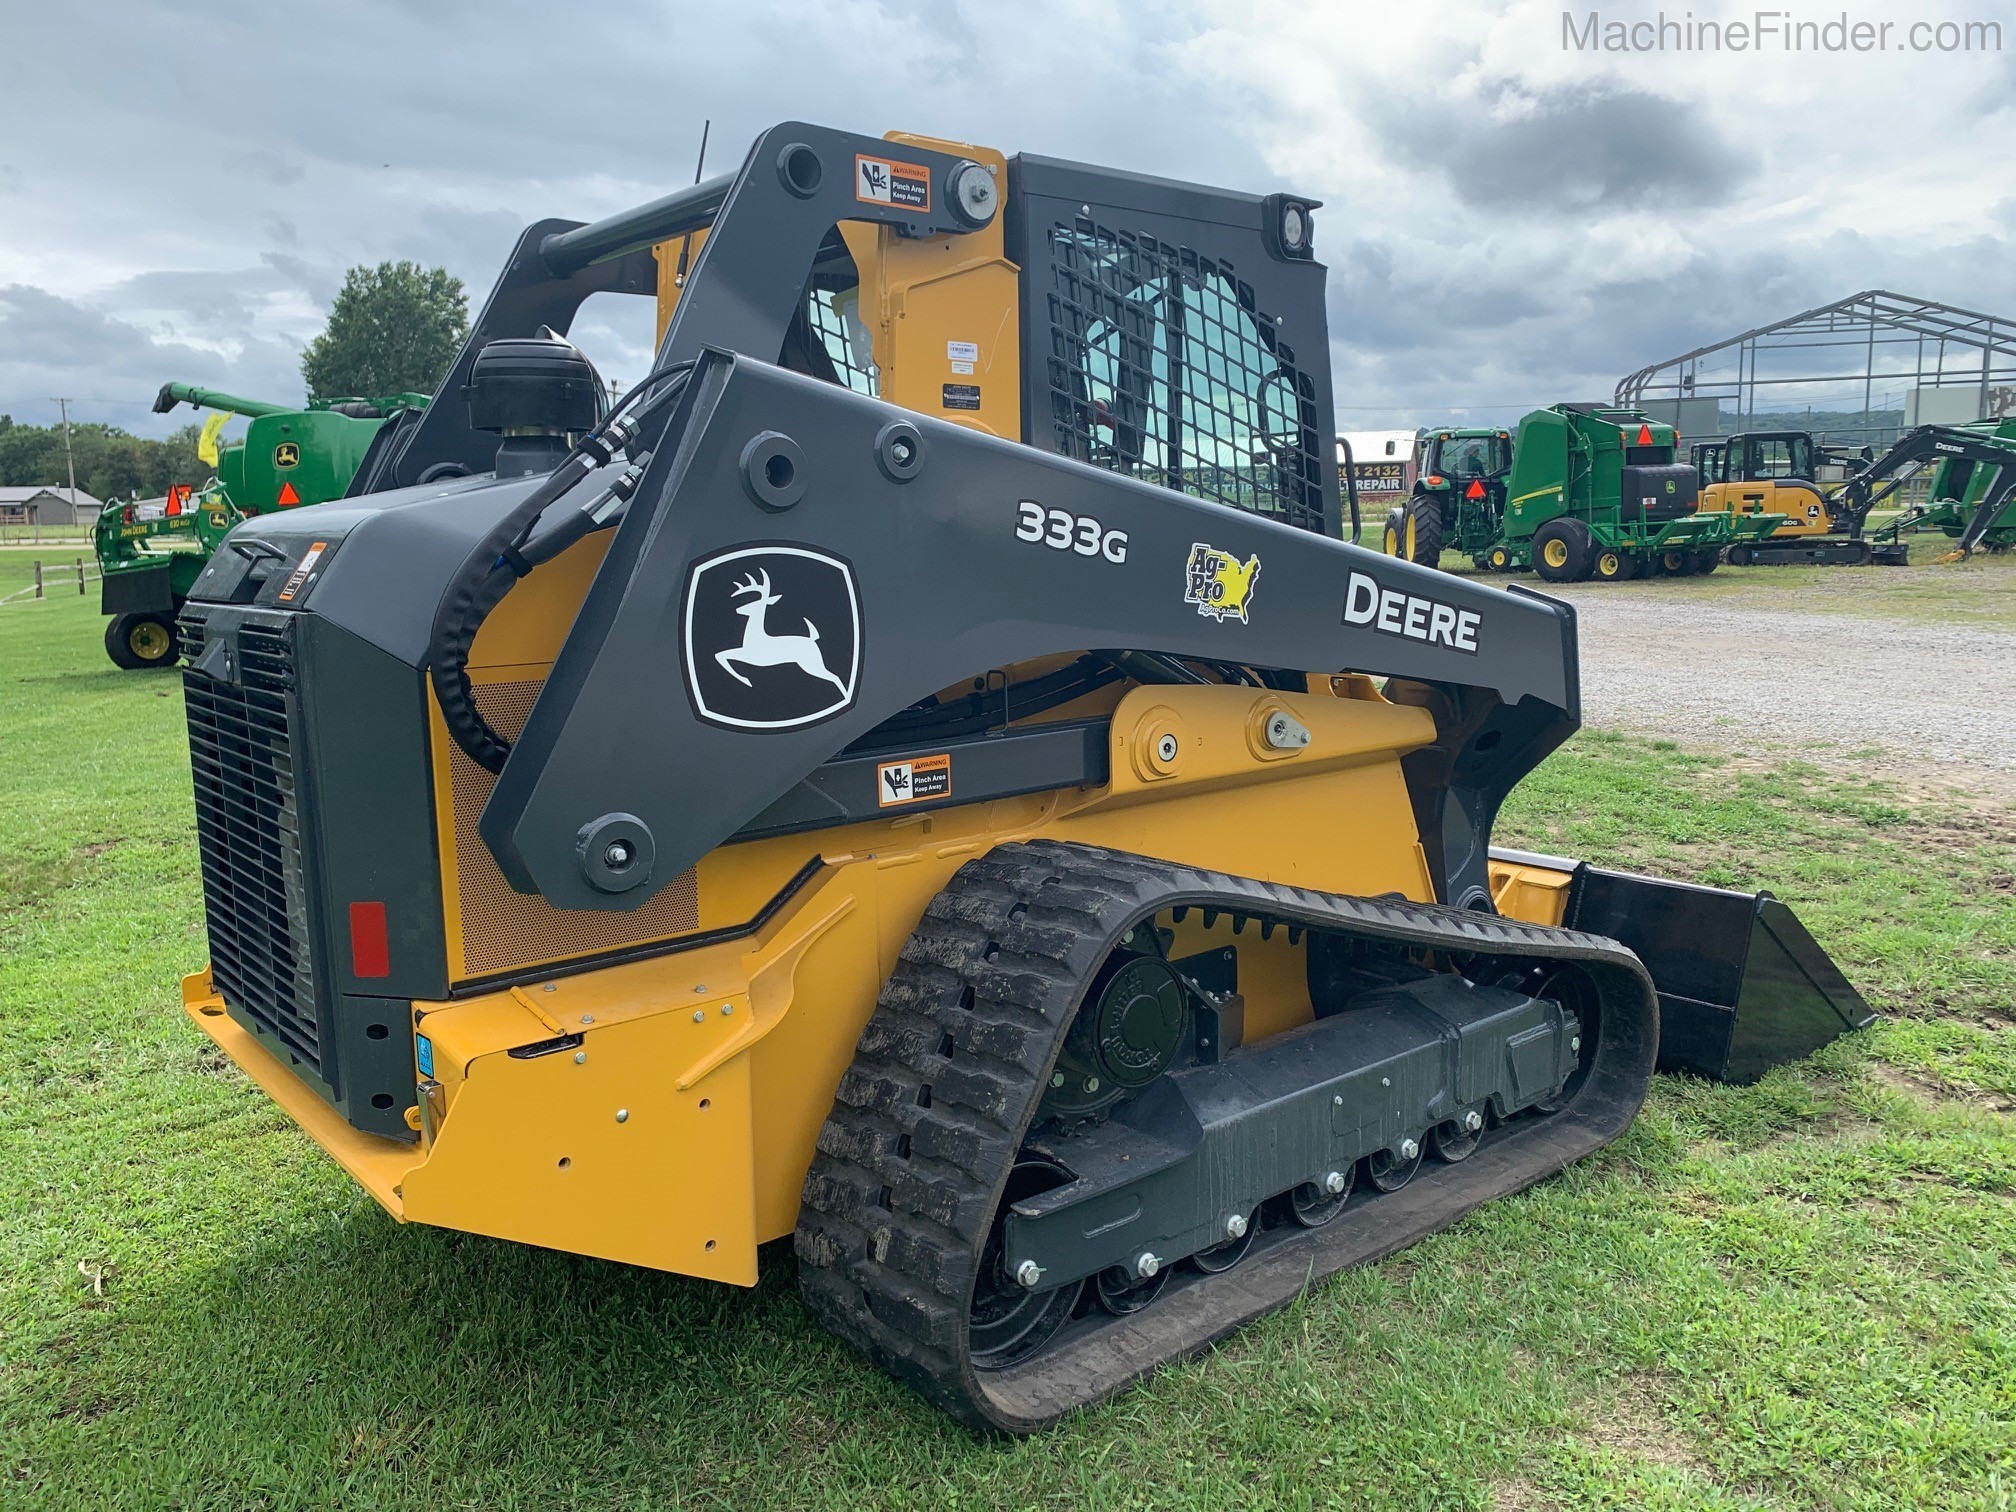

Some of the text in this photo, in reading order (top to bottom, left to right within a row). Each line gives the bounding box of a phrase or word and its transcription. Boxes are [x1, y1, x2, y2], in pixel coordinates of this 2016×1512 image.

[900, 166, 926, 177] WARNING
[892, 181, 925, 194] Pinch Area
[892, 191, 921, 203] Keep Away
[1935, 442, 1965, 453] DEERE
[1829, 458, 1848, 466] DEERE
[1364, 465, 1400, 477] 2132
[1355, 479, 1400, 490] REPAIR
[1015, 501, 1129, 565] 333G
[1189, 547, 1227, 580] Ag-
[1187, 573, 1225, 601] Pro
[1343, 571, 1482, 652] DEERE
[920, 758, 947, 769] WARNING
[914, 774, 946, 785] Pinch Area
[914, 785, 928, 793] Keep
